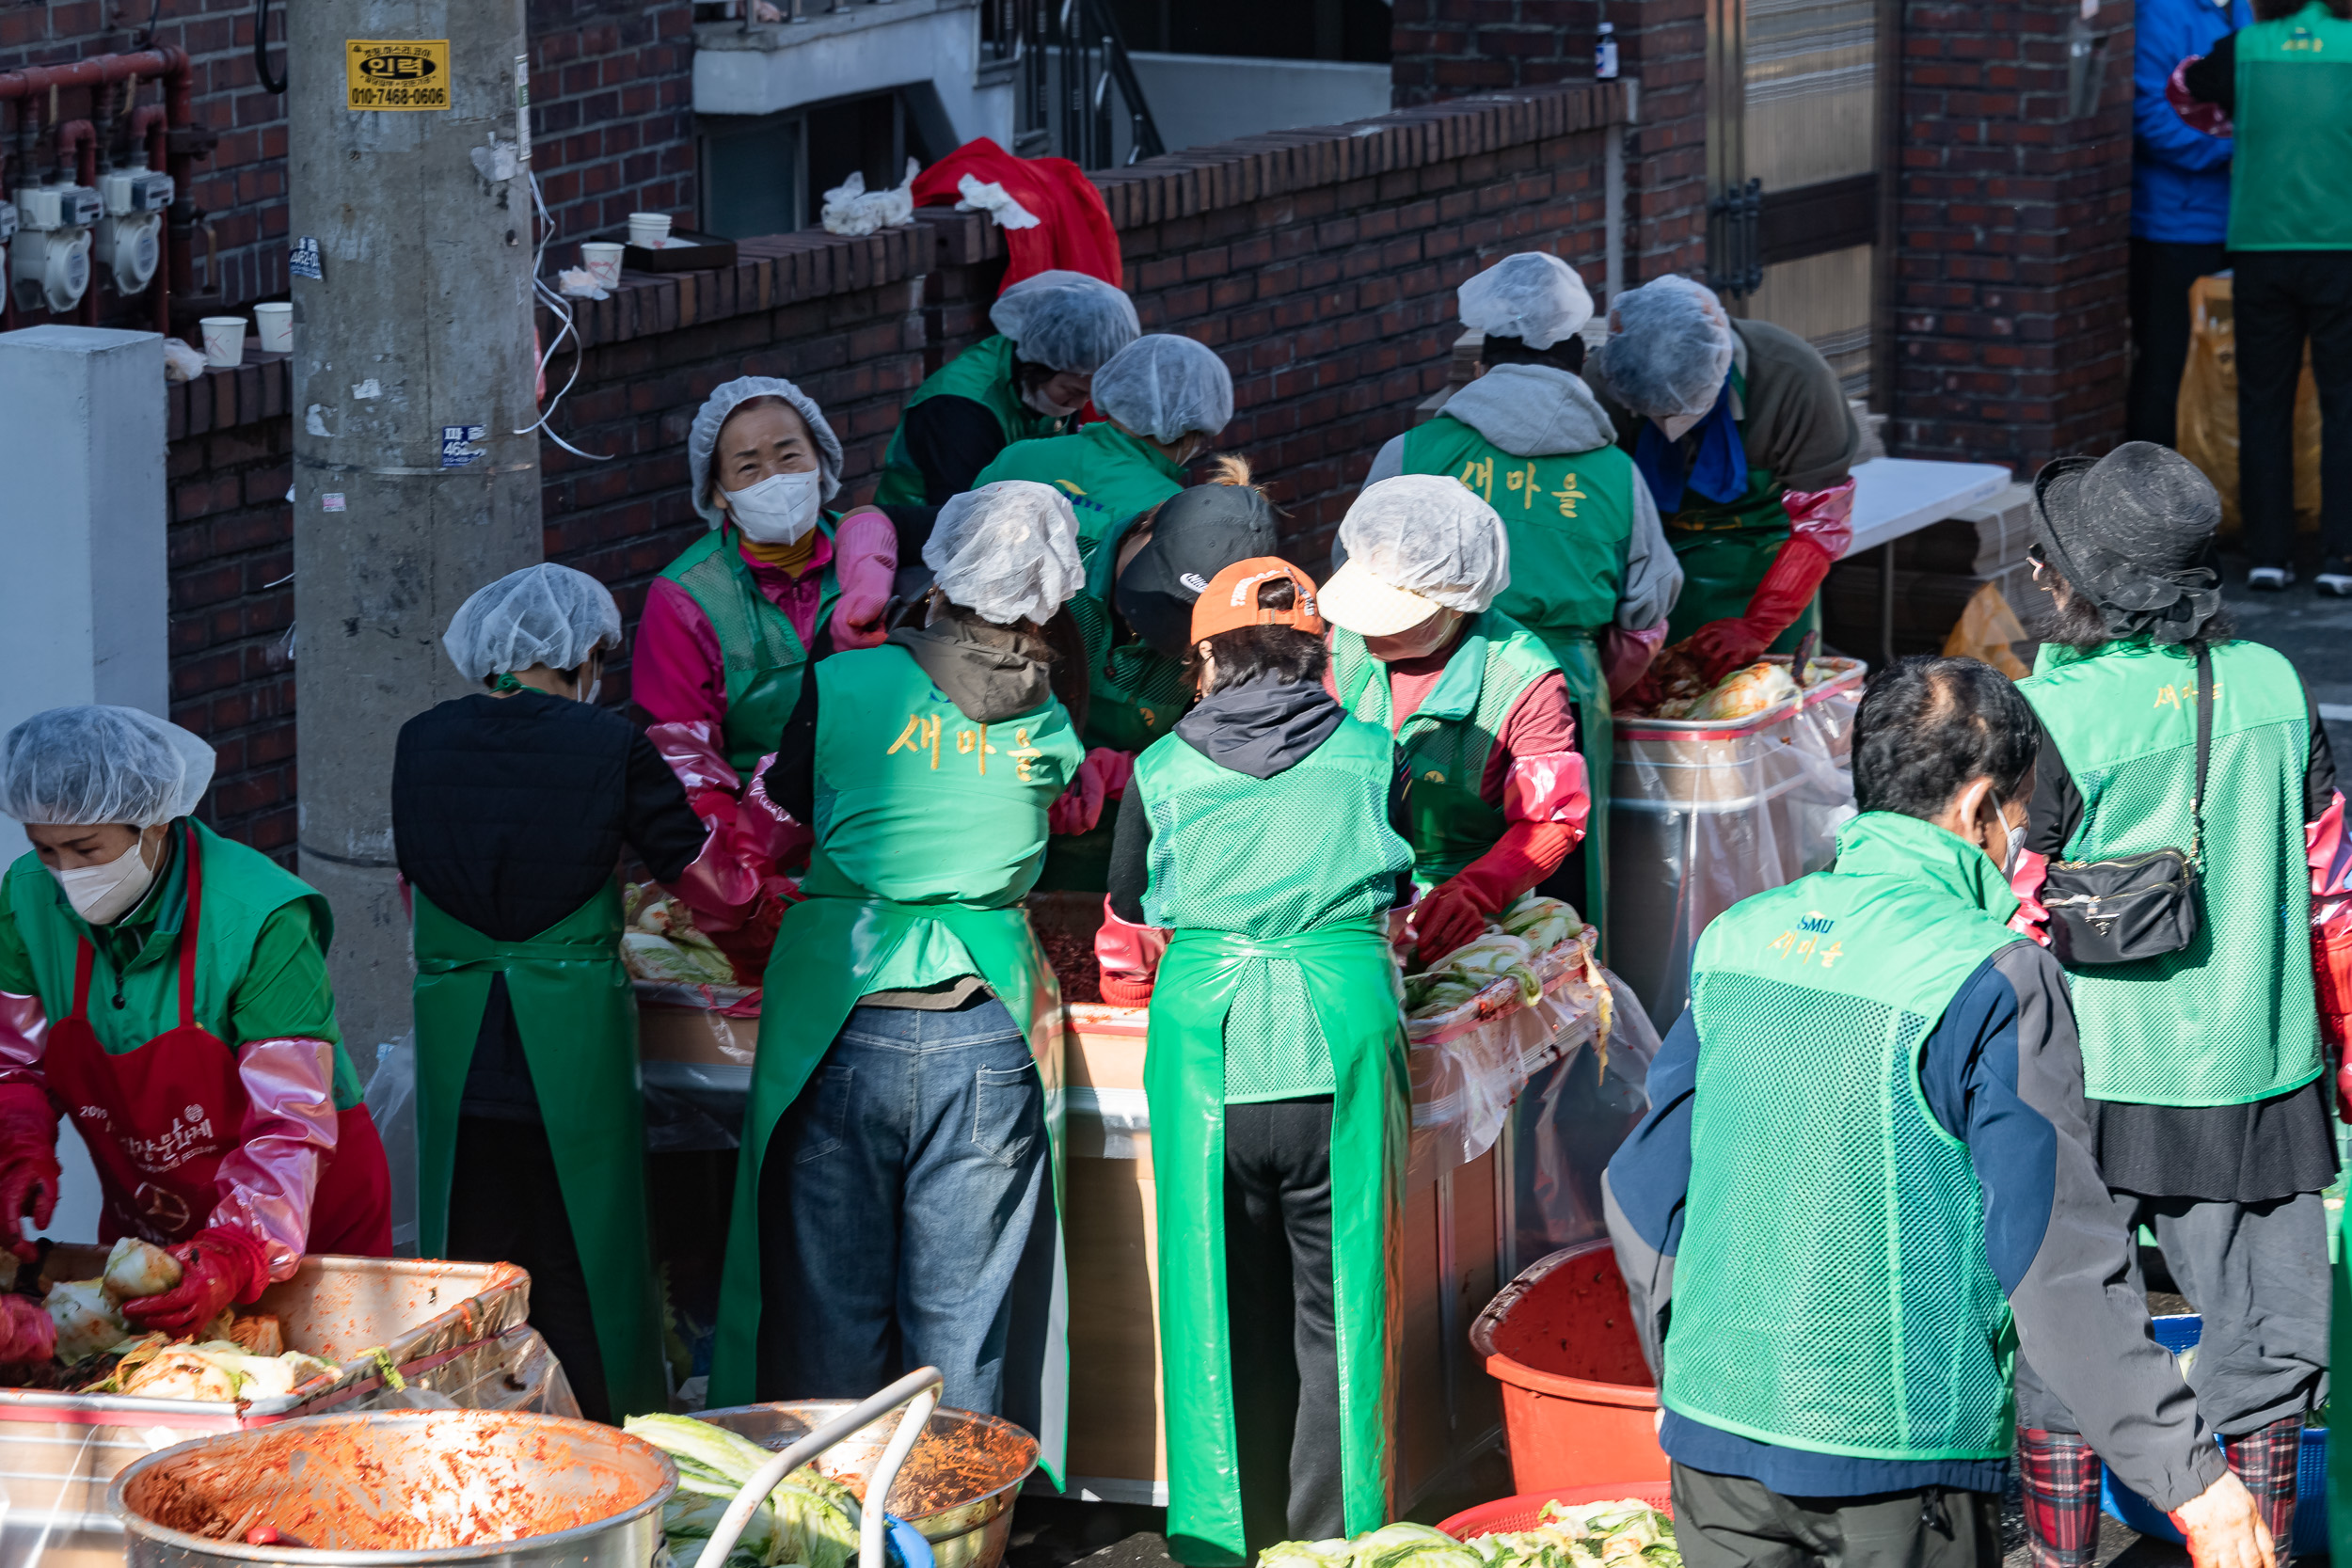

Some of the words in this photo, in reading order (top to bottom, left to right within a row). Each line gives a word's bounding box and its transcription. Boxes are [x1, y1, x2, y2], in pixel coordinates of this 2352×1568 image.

[367, 57, 424, 77] 인력
[351, 87, 445, 104] 010-7468-0606
[1459, 456, 1587, 518] 새마을
[886, 713, 1042, 782] 새마을
[1796, 914, 1835, 934] SMU
[1767, 929, 1844, 968] 새마을
[79, 1105, 109, 1120] 2019
